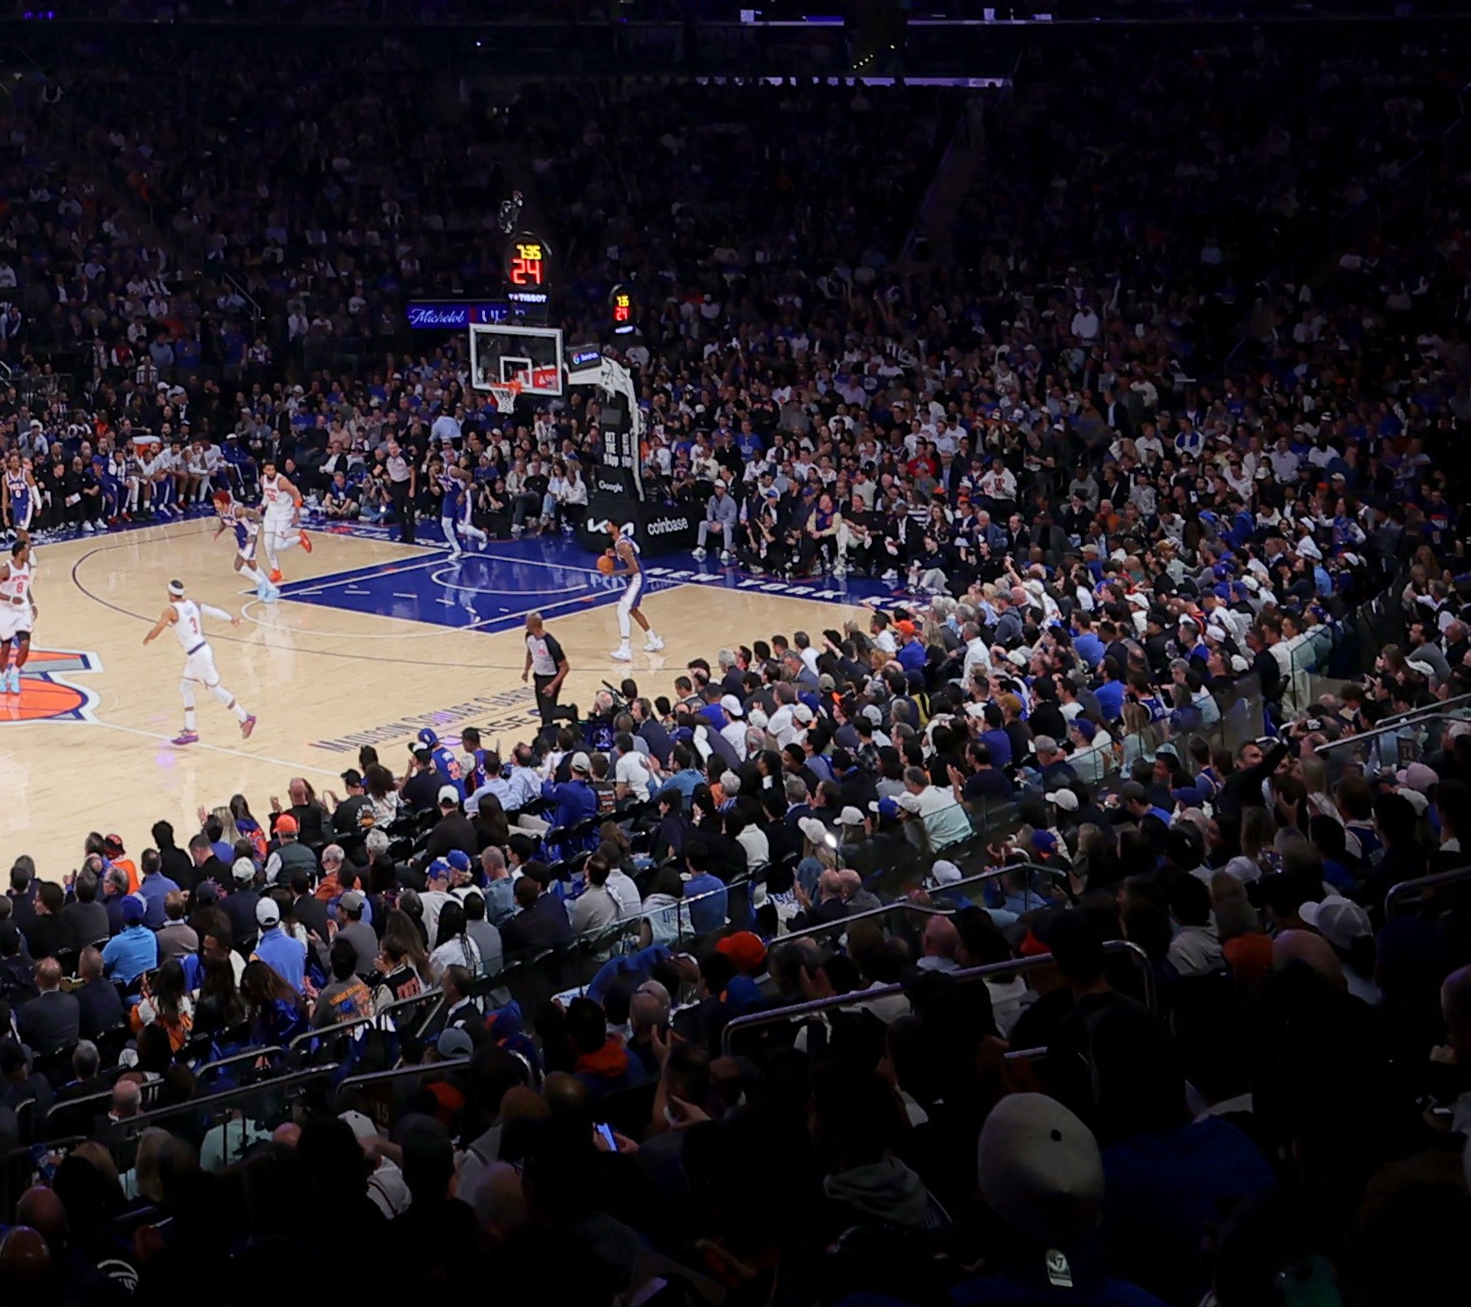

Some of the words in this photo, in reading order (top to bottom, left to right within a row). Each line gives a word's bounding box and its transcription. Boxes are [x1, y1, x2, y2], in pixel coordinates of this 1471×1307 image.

[516, 244, 541, 260] 7:35
[512, 258, 541, 285] 24
[520, 294, 547, 302] TISSOT
[408, 308, 465, 324] Michelob
[616, 307, 628, 321] 24
[599, 479, 623, 493] Google
[647, 516, 688, 535] coinbase
[16, 582, 23, 594] 8
[644, 567, 725, 583] NEW
[738, 578, 846, 600] YORK
[189, 617, 198, 634] 3
[307, 717, 418, 753] MADISON
